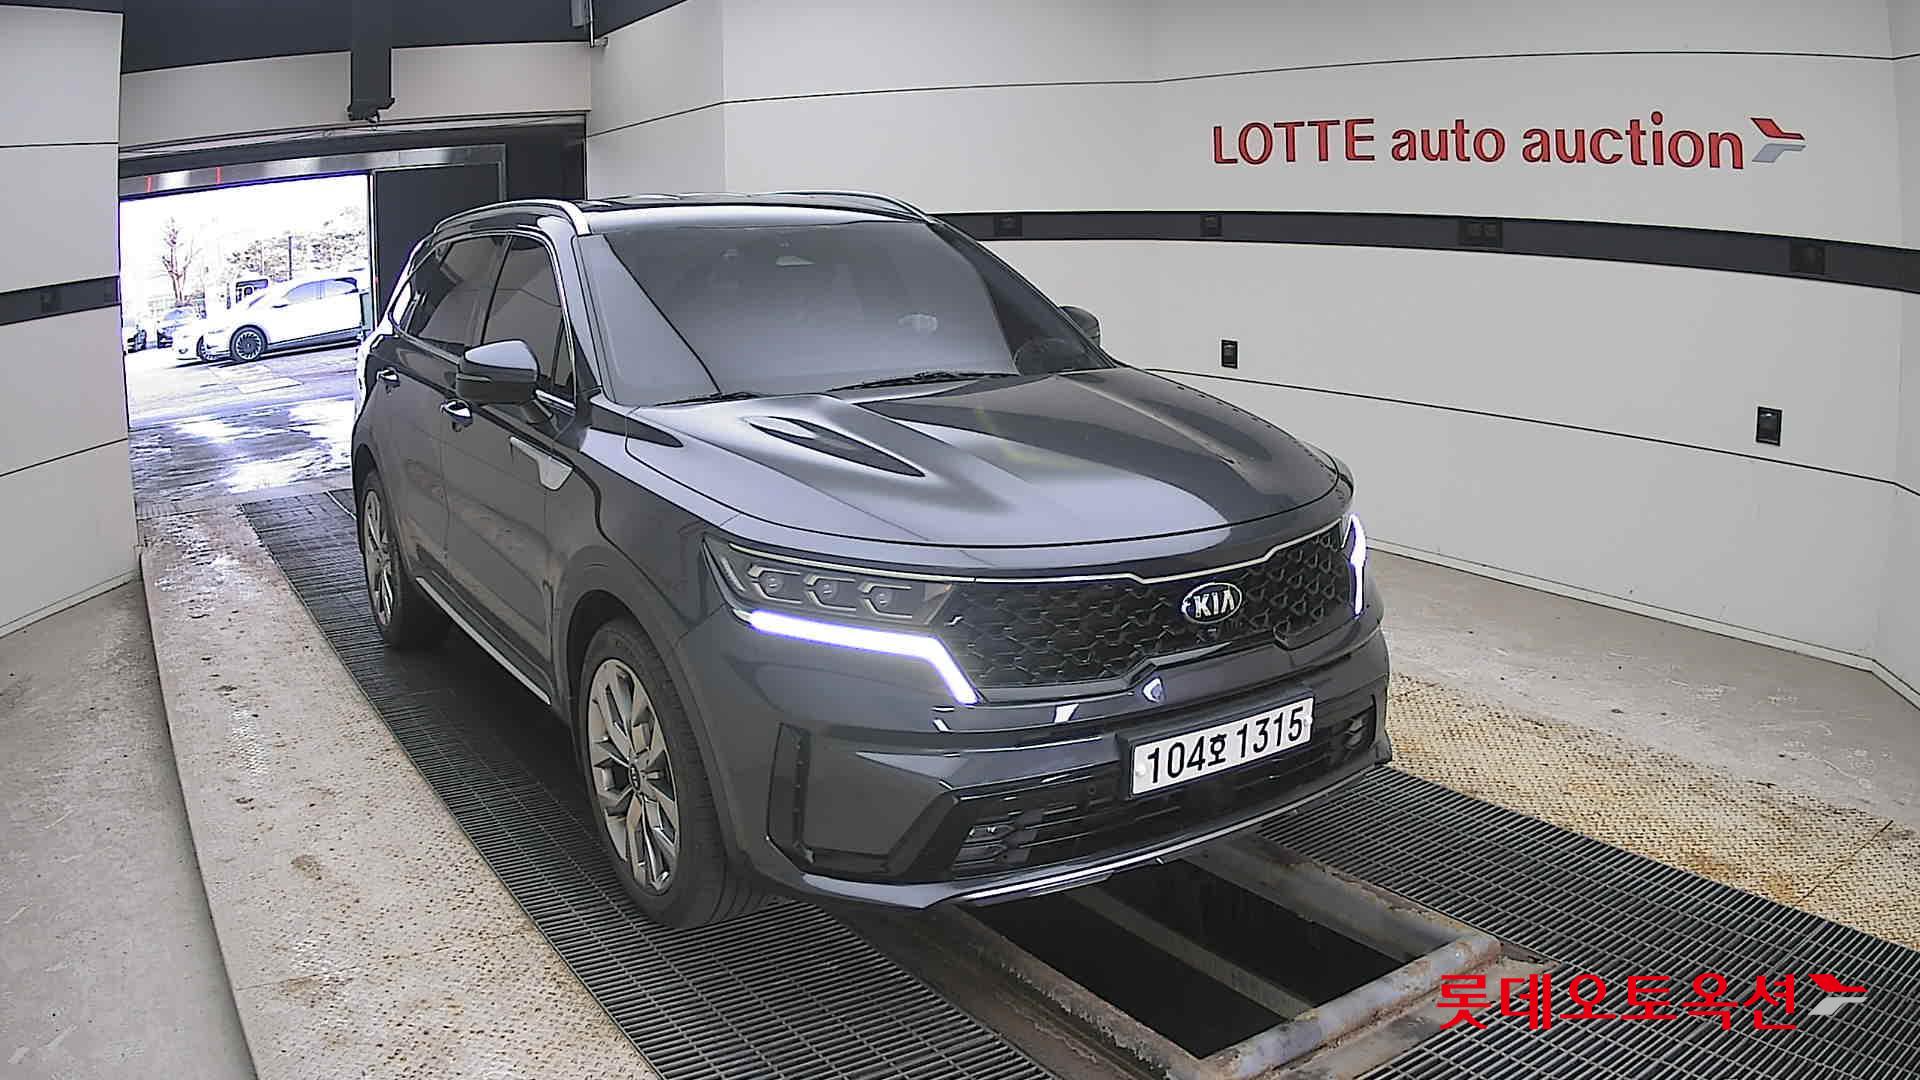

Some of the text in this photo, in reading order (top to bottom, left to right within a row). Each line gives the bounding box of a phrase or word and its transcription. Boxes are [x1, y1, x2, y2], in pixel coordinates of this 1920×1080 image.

[1213, 111, 1744, 170] LOTTE auto auction
[1193, 589, 1235, 618] KIA
[1147, 706, 1304, 783] 104호 1315
